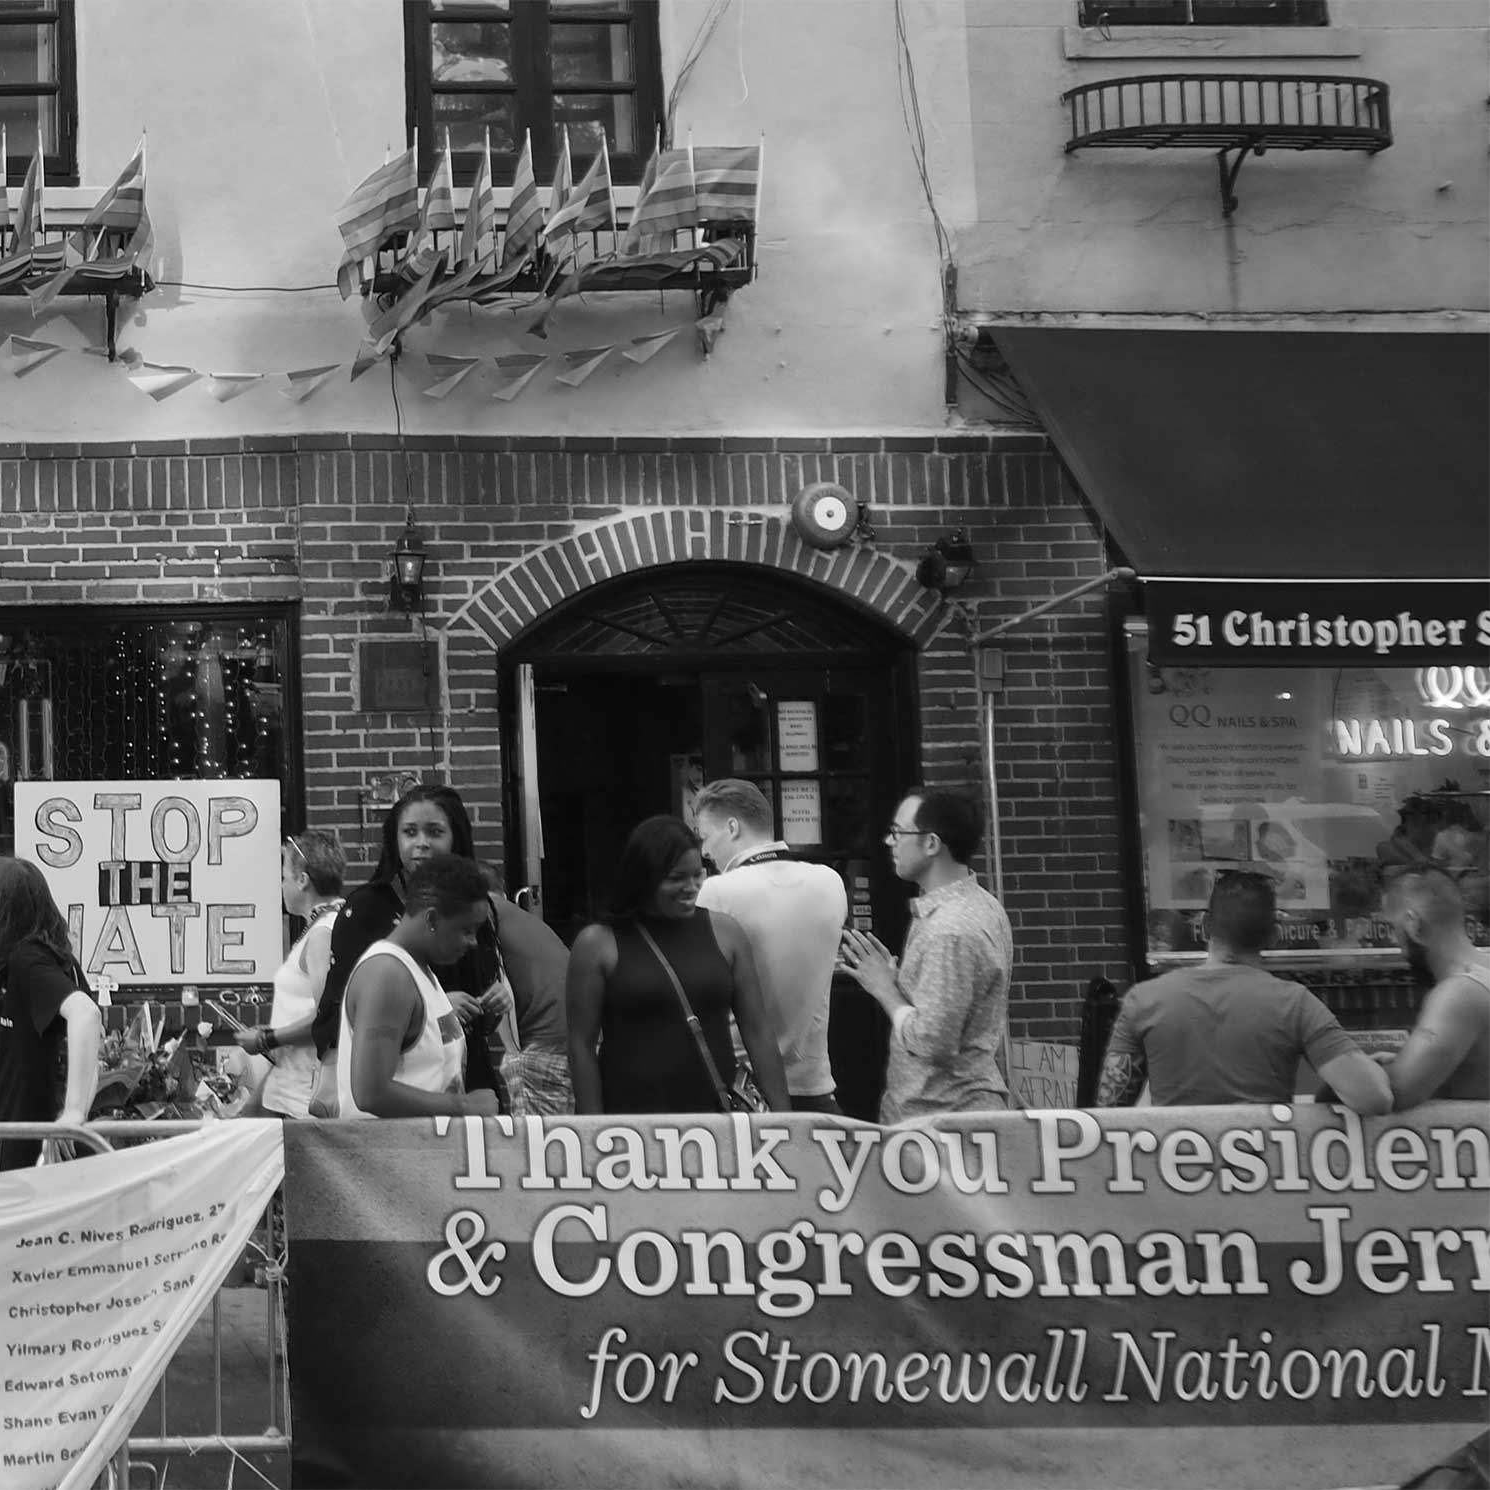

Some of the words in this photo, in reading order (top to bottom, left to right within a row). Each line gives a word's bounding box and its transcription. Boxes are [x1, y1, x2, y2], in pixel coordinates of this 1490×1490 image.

[1173, 613, 1213, 646] 51
[1221, 610, 1466, 654] Christopher
[1169, 704, 1211, 728] QQ
[1217, 717, 1256, 728] NAILS
[1271, 717, 1298, 728] SPA
[1336, 719, 1453, 755] NAILS
[35, 793, 259, 868] STOP
[99, 861, 191, 906] THE
[1012, 1041, 1032, 1071] I
[1039, 1045, 1066, 1073] AM
[434, 1113, 797, 1192] Thank
[811, 1128, 1009, 1212] you
[1025, 1104, 1490, 1195] Presiden
[16, 1235, 53, 1249] Jean
[58, 1231, 75, 1244] C.
[80, 1228, 124, 1242] Nives
[12, 1270, 63, 1284] Xavier
[67, 1256, 149, 1278] Emmanuel
[426, 1210, 507, 1297] &
[532, 1204, 1269, 1318] Congressman
[8, 1300, 102, 1319] Christopher
[6, 1344, 66, 1357] Yilmary
[4, 1377, 64, 1393] Edward
[579, 1326, 699, 1420] for
[713, 1327, 1088, 1404] Stonewall
[1103, 1322, 1446, 1404] National
[3, 1417, 52, 1430] Shane
[58, 1409, 97, 1424] Evan
[3, 1452, 55, 1467] Martin
